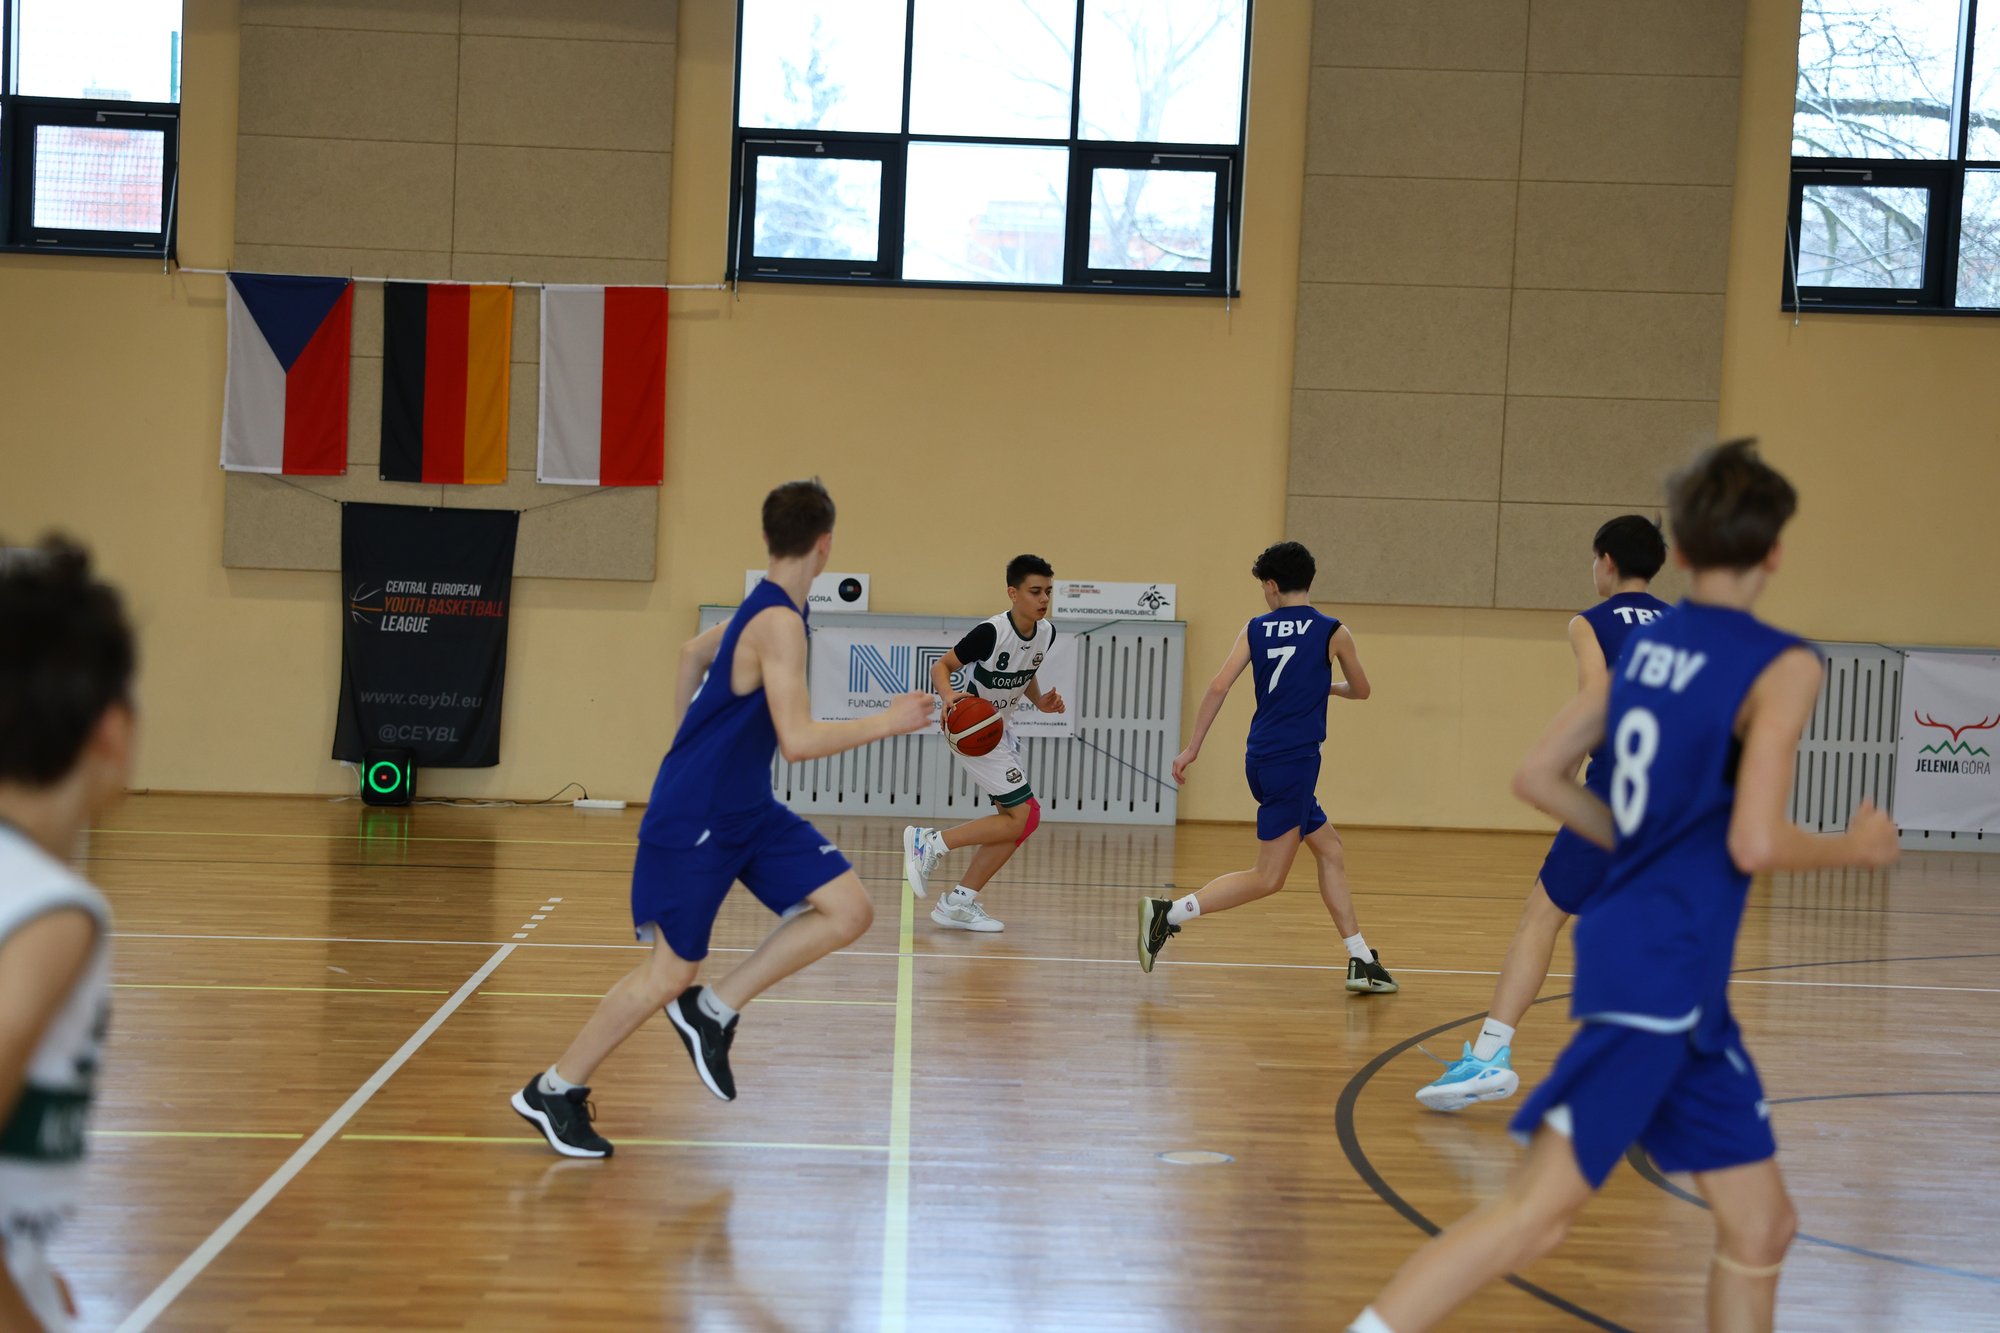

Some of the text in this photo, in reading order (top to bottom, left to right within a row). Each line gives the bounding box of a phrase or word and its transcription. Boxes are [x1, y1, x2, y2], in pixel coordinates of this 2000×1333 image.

[386, 580, 481, 597] CENTRAL EUROPEAN
[384, 596, 504, 617] YOUTH BASKETBALL
[808, 594, 832, 603] GÓRA
[1069, 607, 1114, 615] VIVIDBOOKS
[1114, 608, 1157, 616] PARDUBICE
[380, 615, 430, 633] LEAGUE
[1262, 619, 1313, 637] TBV
[995, 651, 1010, 671] 8
[1267, 646, 1297, 694] 7
[1625, 639, 1708, 693] TBV
[360, 690, 482, 709] www.ceybl.eu
[378, 723, 460, 743] @CEYBL
[1611, 707, 1660, 837] 8
[1915, 758, 1991, 775] JELENIA GÓRA
